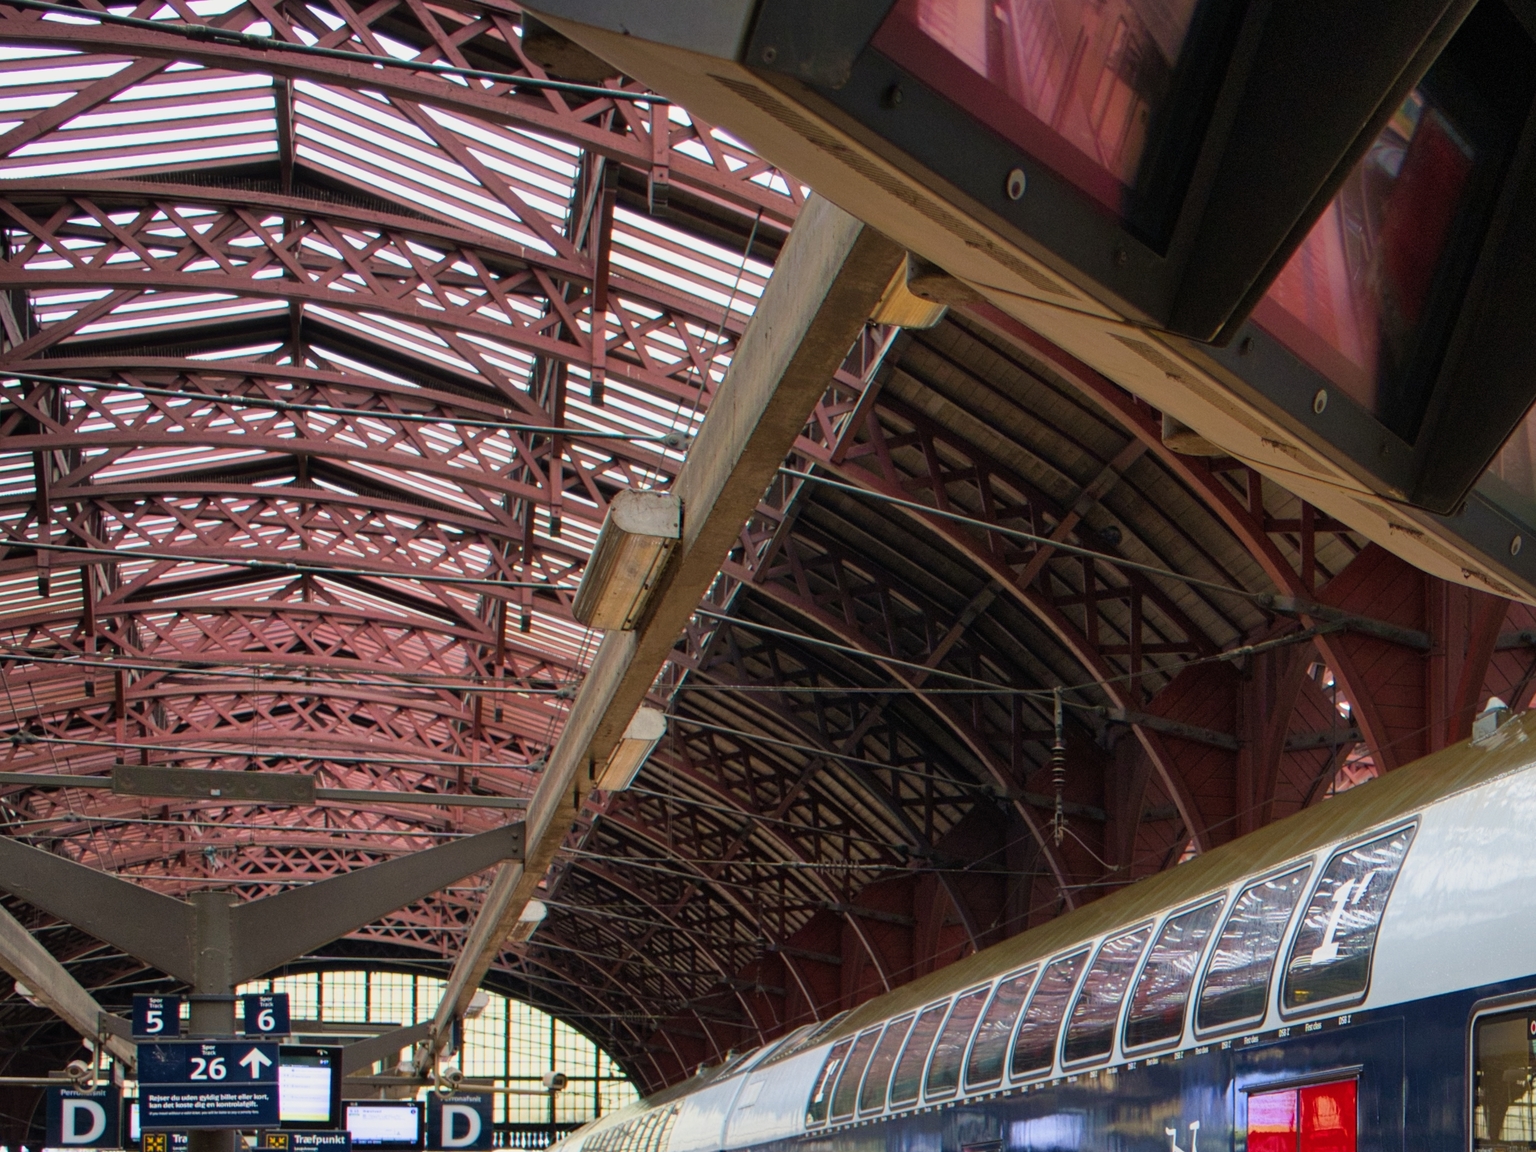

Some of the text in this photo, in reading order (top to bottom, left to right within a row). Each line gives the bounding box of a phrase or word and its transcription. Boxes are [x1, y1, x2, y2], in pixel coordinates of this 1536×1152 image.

[146, 1010, 164, 1033] 5
[257, 1009, 276, 1031] 6
[190, 1057, 227, 1080] 26
[149, 1095, 170, 1103] Rejser
[199, 1094, 219, 1102] gyldig
[194, 1101, 206, 1109] dig
[62, 1099, 107, 1144] D
[441, 1105, 481, 1148] D
[294, 1134, 346, 1146] Træfpunkt
